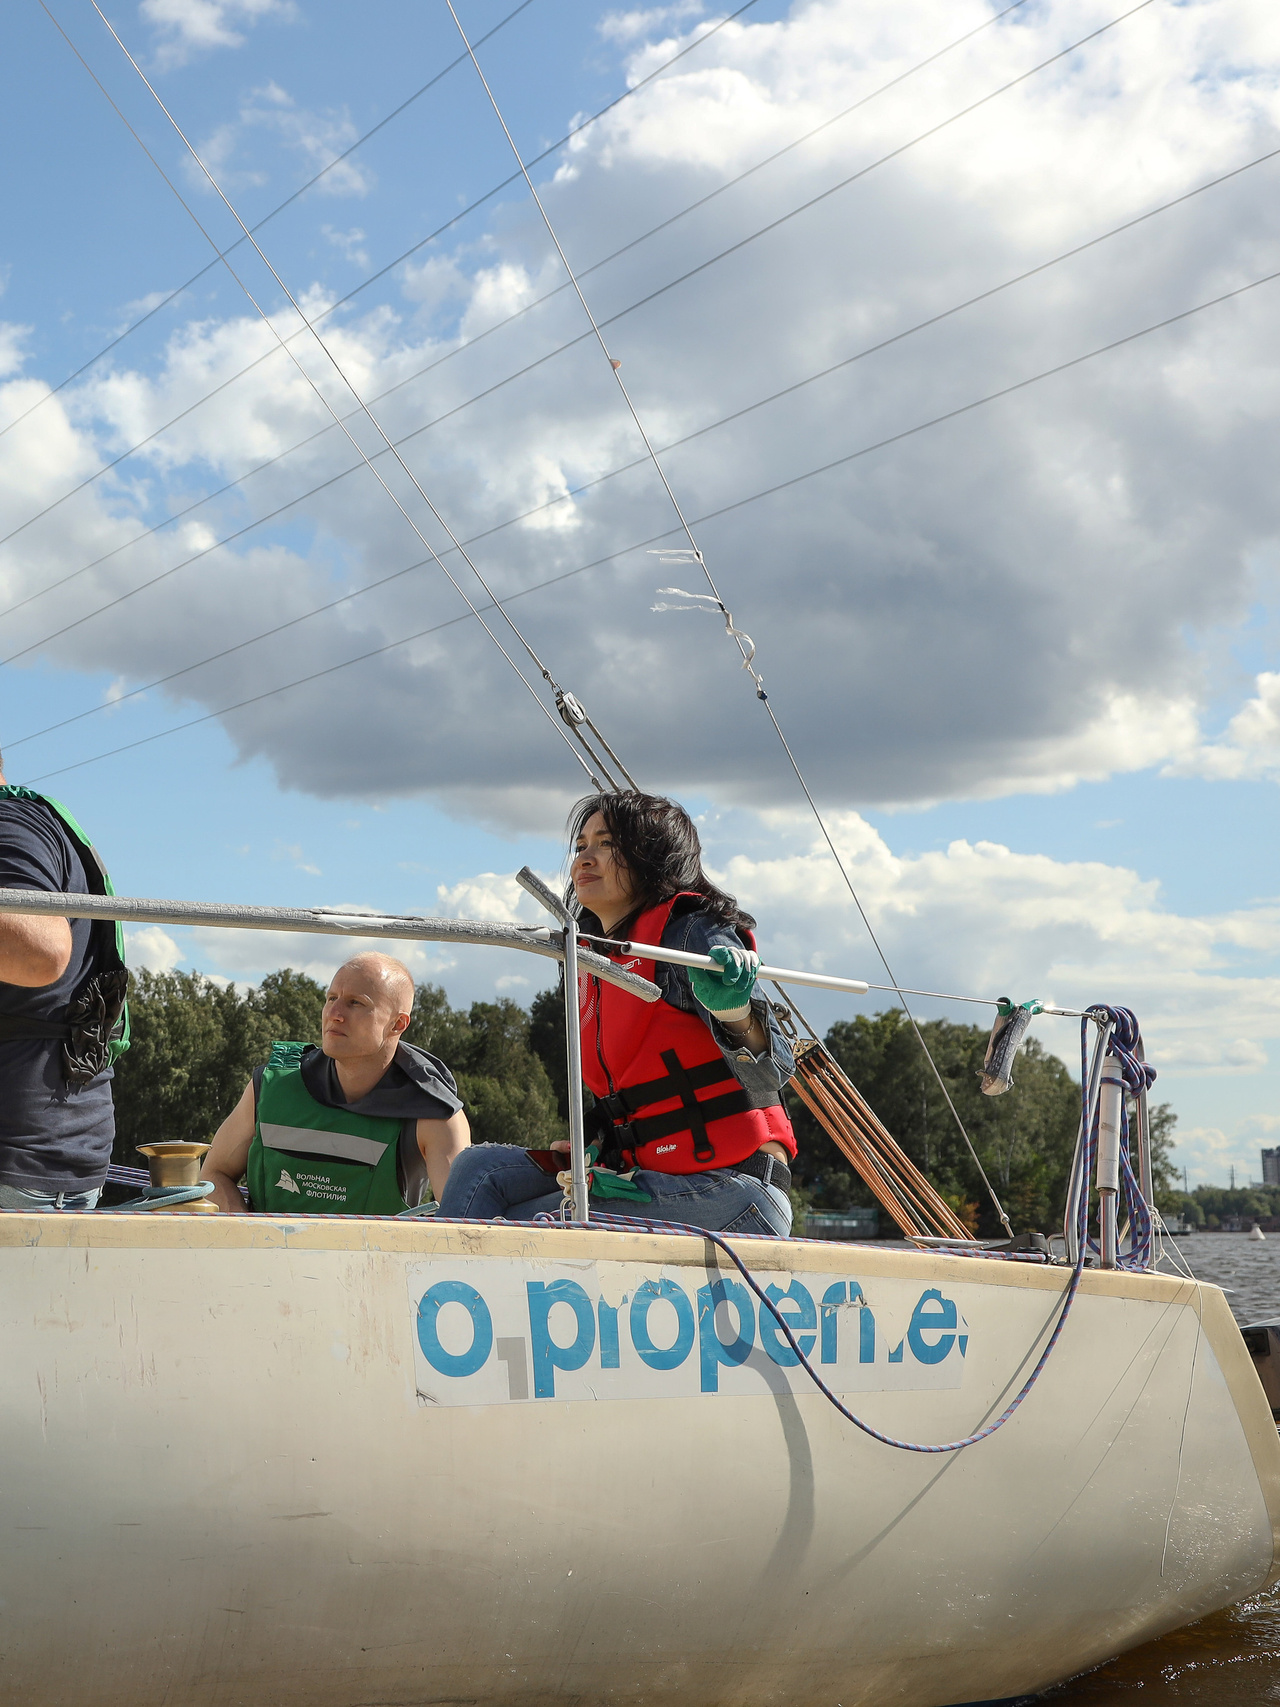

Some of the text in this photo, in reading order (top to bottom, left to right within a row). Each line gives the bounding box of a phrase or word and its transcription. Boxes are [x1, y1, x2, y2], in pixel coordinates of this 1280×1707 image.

[296, 1172, 331, 1184] ВОЛЬНАЯ
[301, 1181, 347, 1193] МОСКОВСКАЯ
[305, 1189, 347, 1202] ФЛОТИЛИЯ
